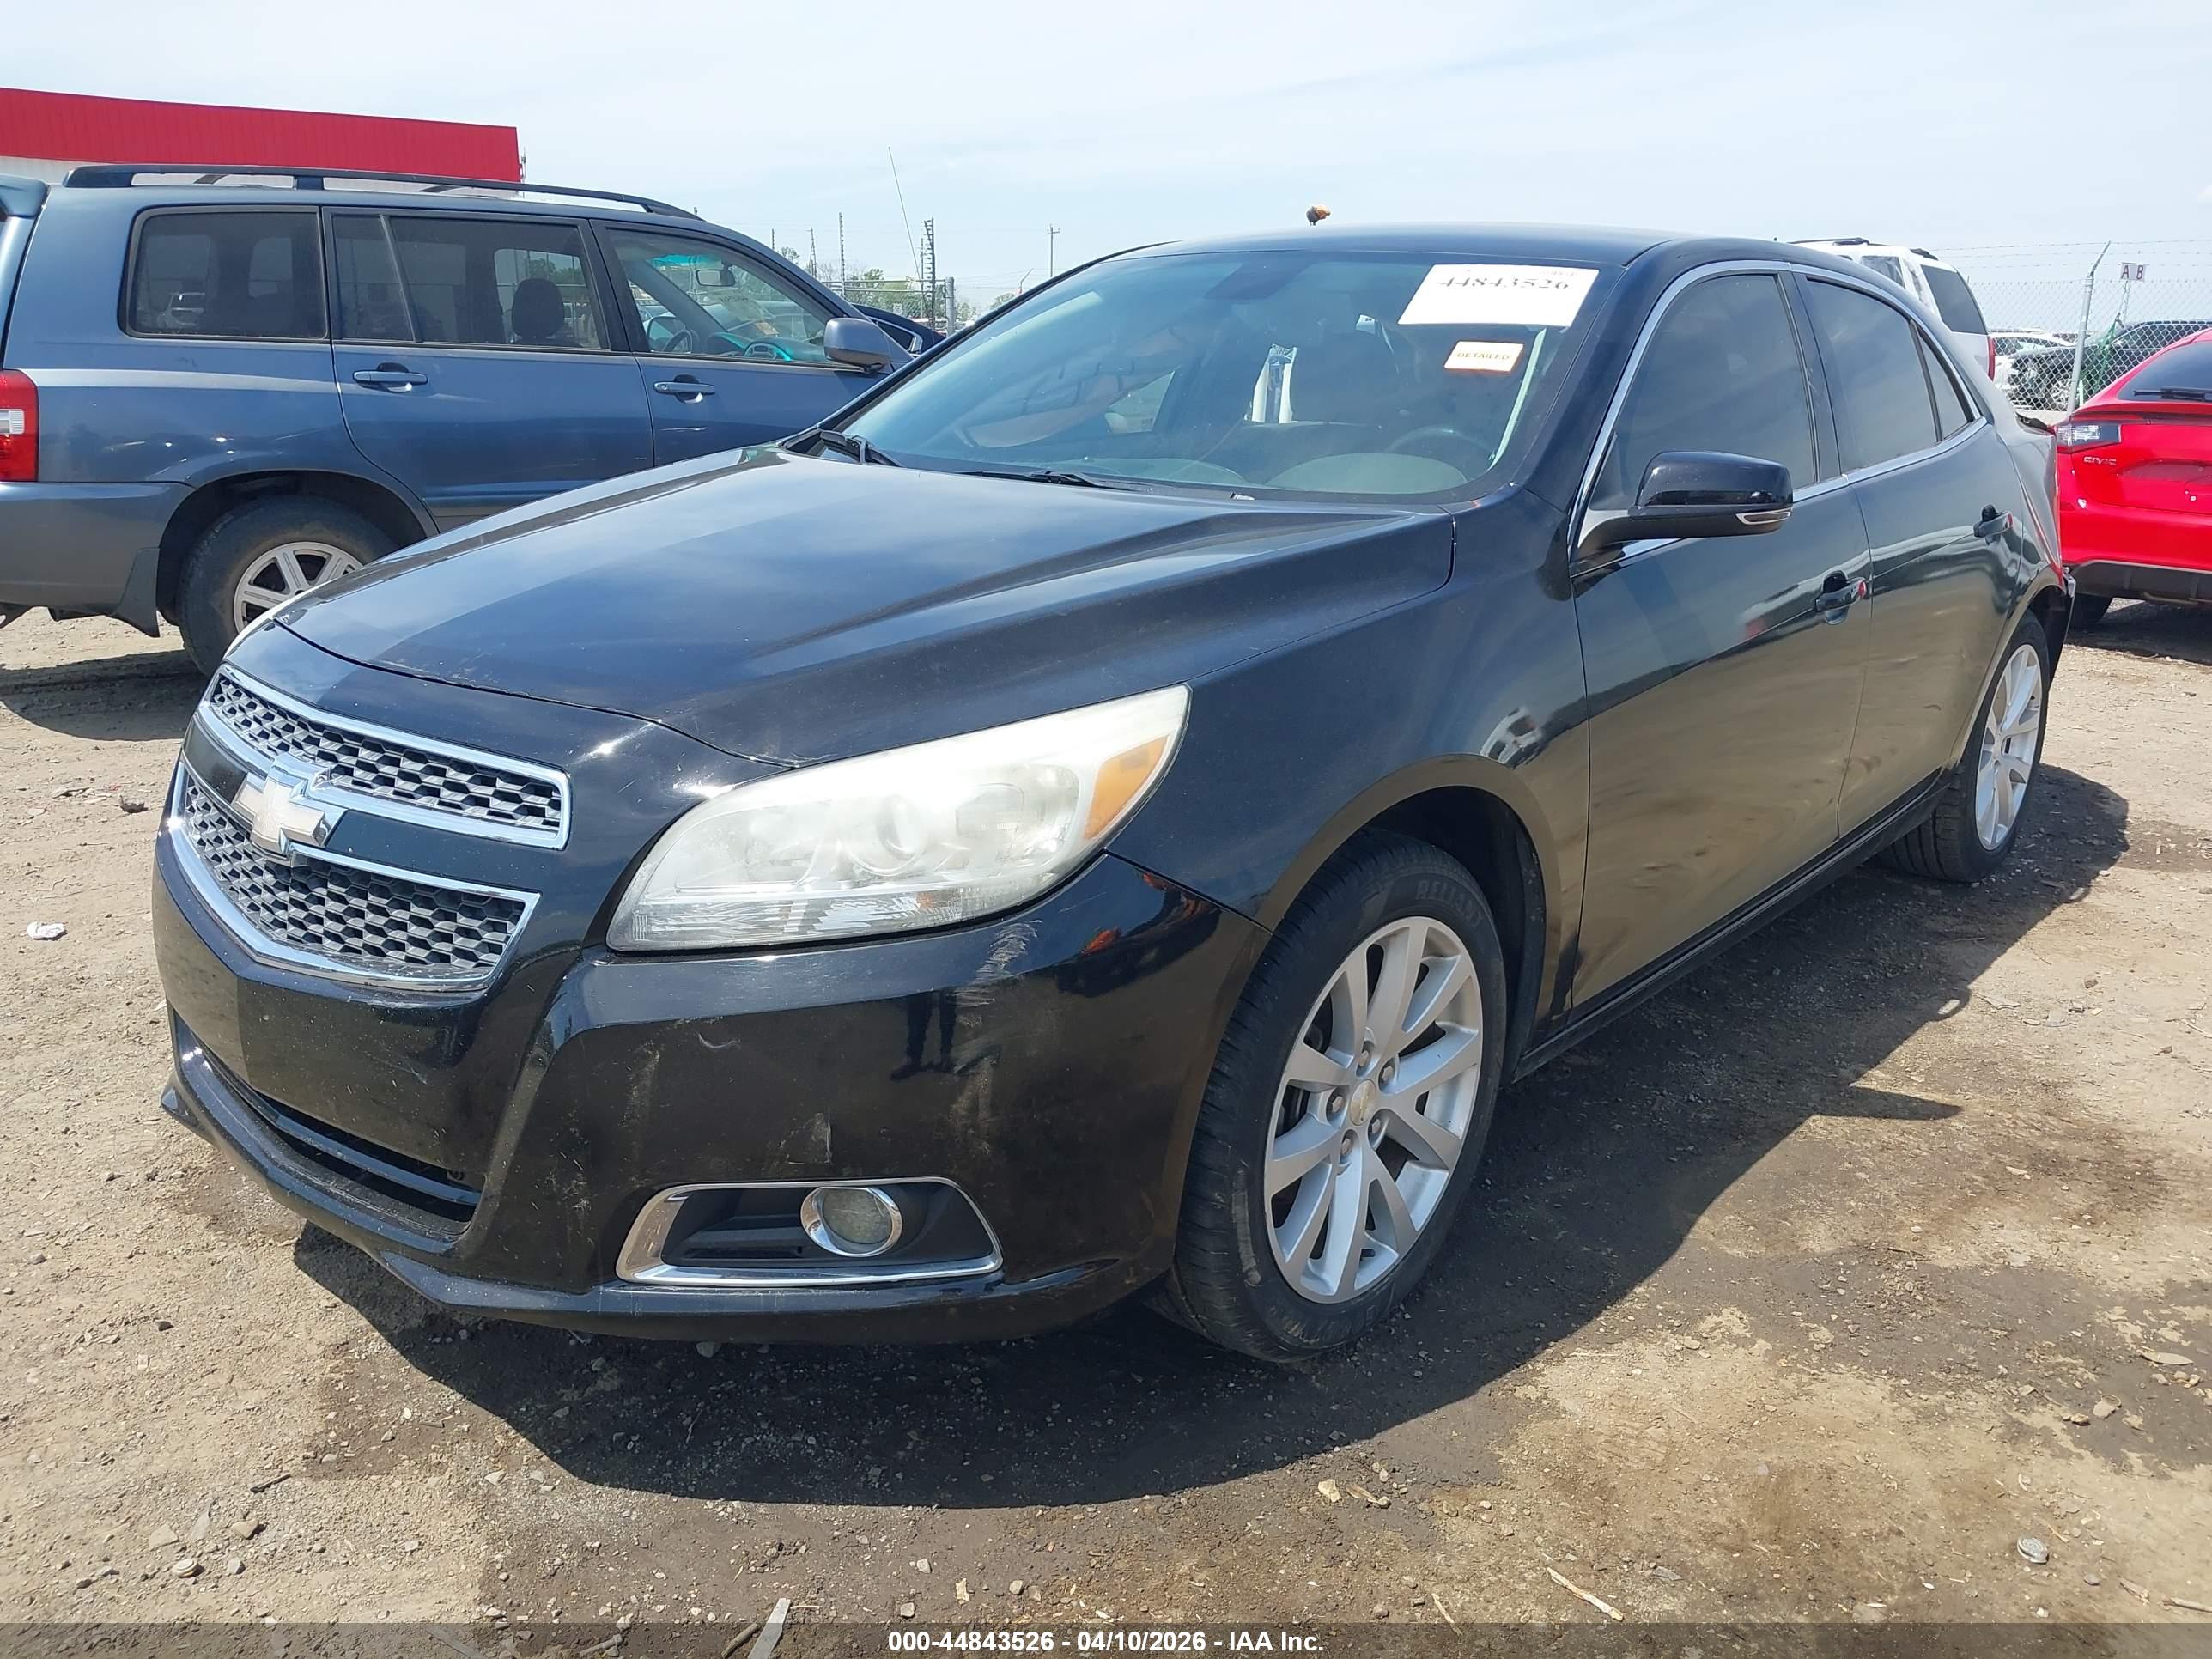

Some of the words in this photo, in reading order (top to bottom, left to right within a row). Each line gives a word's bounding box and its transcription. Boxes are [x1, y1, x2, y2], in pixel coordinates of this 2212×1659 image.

[2121, 265, 2129, 279] A
[2136, 265, 2143, 280] B
[1439, 276, 1571, 289] 44843526
[1456, 352, 1510, 361] DETAILED
[2084, 456, 2117, 466] CIVIC
